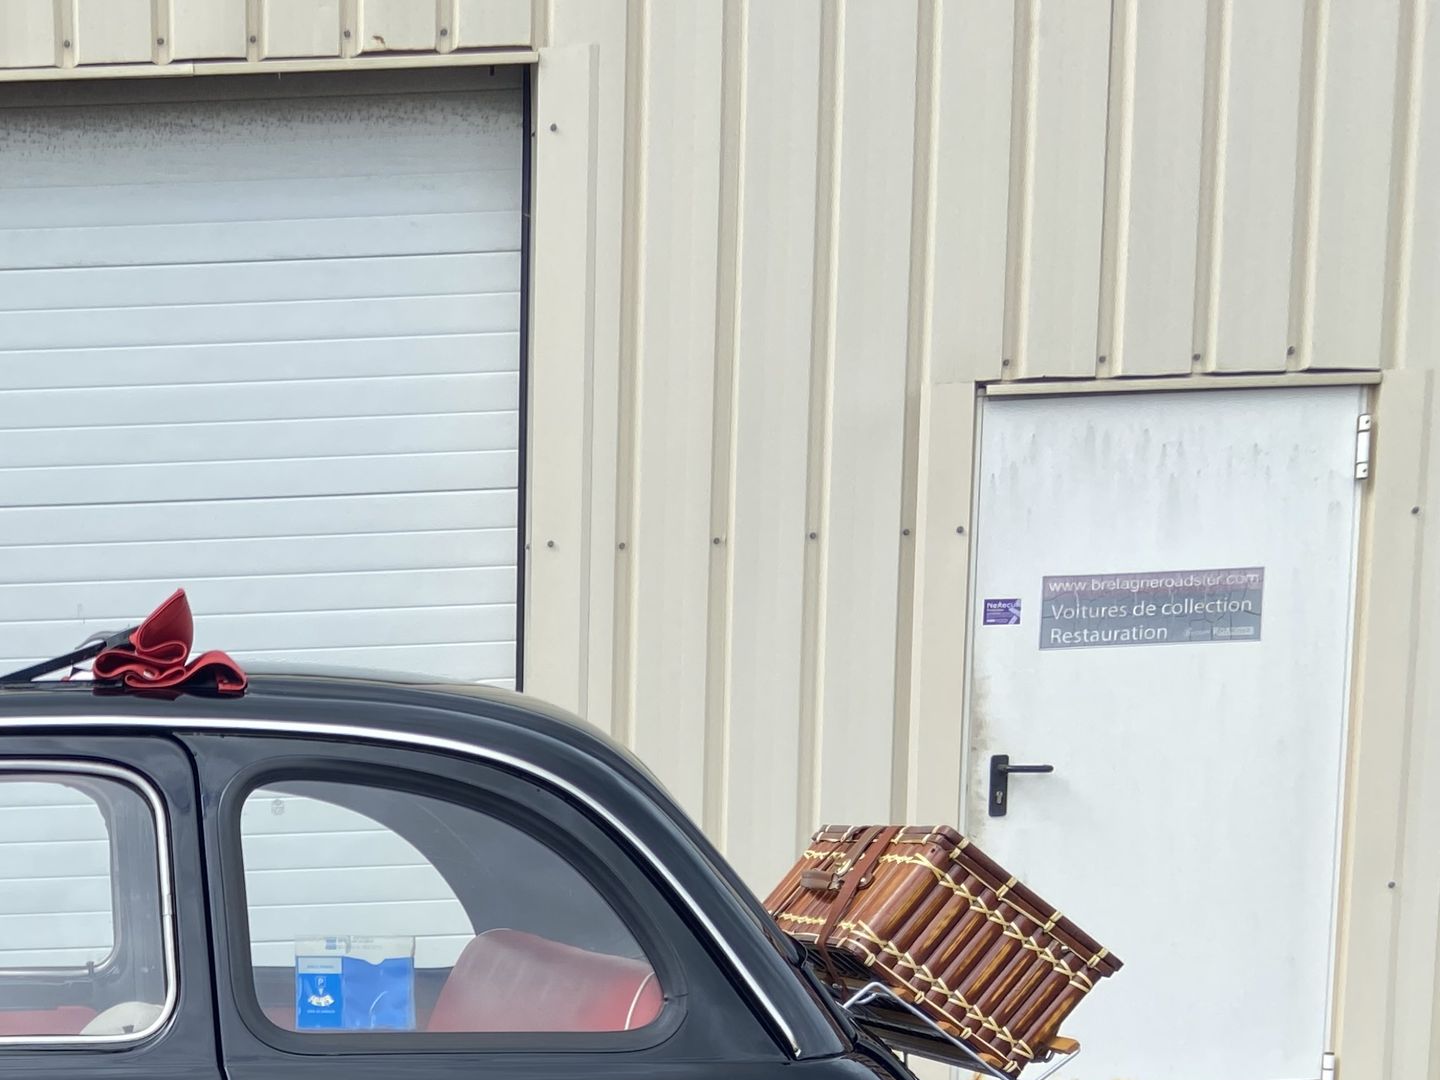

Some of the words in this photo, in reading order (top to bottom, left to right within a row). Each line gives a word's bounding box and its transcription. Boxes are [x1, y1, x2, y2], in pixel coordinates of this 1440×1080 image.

[1051, 603, 1128, 620] Voitures
[1132, 600, 1157, 616] de
[1161, 597, 1252, 615] collection
[1050, 625, 1168, 644] Restauration
